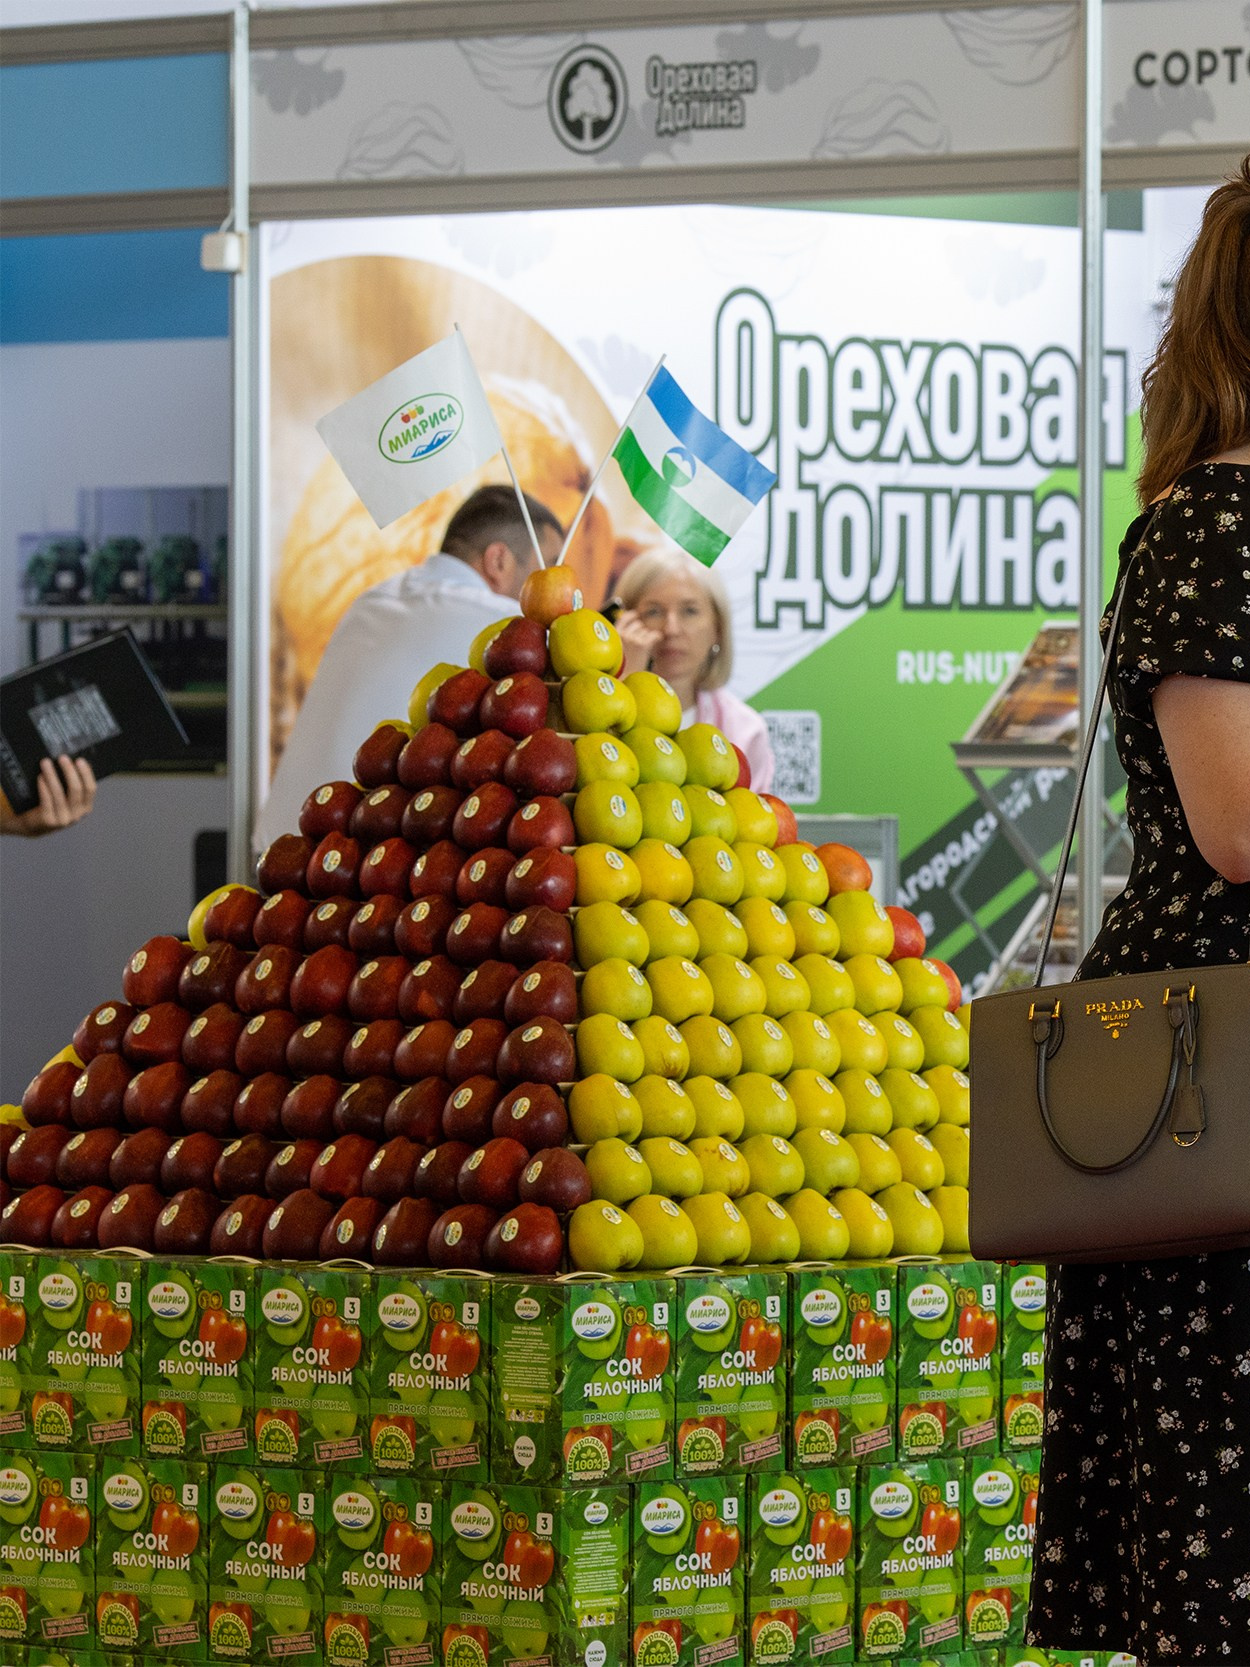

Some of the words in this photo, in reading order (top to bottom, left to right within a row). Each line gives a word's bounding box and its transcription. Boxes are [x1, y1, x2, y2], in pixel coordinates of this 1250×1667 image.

[645, 54, 758, 100] Ореховая
[387, 402, 457, 454] МИАРИСА
[1085, 998, 1145, 1015] PRADA
[1100, 1012, 1130, 1022] MILANO
[13, 1279, 21, 1293] 3
[41, 1286, 75, 1296] МИАРИСА
[120, 1286, 127, 1298] 3
[150, 1294, 187, 1305] МИАРИСА
[234, 1294, 241, 1307] 3
[880, 1293, 886, 1306] 3
[911, 1296, 945, 1306] МИАРИСА
[986, 1288, 992, 1301] 3
[264, 1301, 300, 1311] МИАРИСА
[348, 1301, 356, 1314] 3
[382, 1306, 416, 1317] МИАРИСА
[690, 1307, 726, 1318] МИАРИСА
[770, 1300, 777, 1312] 3
[804, 1301, 838, 1312] МИАРИСА
[467, 1306, 474, 1320] 3
[657, 1306, 664, 1320] 3
[575, 1314, 612, 1326] МИАРИСА
[67, 1331, 102, 1349] СОК
[941, 1337, 973, 1355] СОК
[180, 1340, 215, 1357] СОК
[833, 1344, 866, 1362] СОК
[48, 1351, 122, 1368] ЯБЛОЧНЫЙ
[293, 1347, 329, 1365] СОК
[410, 1353, 447, 1371] СОК
[721, 1350, 756, 1368] СОК
[159, 1360, 237, 1377] ЯБЛОЧНЫЙ
[606, 1358, 642, 1376] СОК
[919, 1353, 992, 1376] ЯБЛОЧНЫЙ
[272, 1367, 352, 1385] ЯБЛОЧНЫЙ
[812, 1360, 885, 1383] ЯБЛОЧНЫЙ
[388, 1373, 469, 1391] ЯБЛОЧНЫЙ
[698, 1367, 775, 1390] ЯБЛОЧНЫЙ
[46, 1379, 84, 1392] ПРЯМОГО
[583, 1374, 662, 1398] ЯБЛОЧНЫЙ
[157, 1388, 198, 1402] ПРЯМОГО
[920, 1388, 957, 1400] ПРЯМОГО
[271, 1396, 311, 1409] ПРЯМОГО
[813, 1395, 850, 1408] ПРЯМОГО
[388, 1402, 427, 1416] ПРЯМОГО
[698, 1402, 738, 1415] ПРЯМОГО
[584, 1411, 624, 1424] ПРЯМОГО
[40, 1422, 65, 1435] 100%
[1014, 1424, 1039, 1436] 100%
[151, 1432, 178, 1445] 100%
[911, 1434, 937, 1446] 100%
[264, 1440, 291, 1453] 100%
[805, 1441, 830, 1454] 100%
[380, 1446, 406, 1461] 100%
[689, 1449, 716, 1462] 100%
[575, 1458, 602, 1471] 100%
[75, 1481, 83, 1494] 3
[105, 1486, 140, 1498] МИАРИСА
[949, 1484, 956, 1497] 3
[976, 1482, 1010, 1494] МИАРИСА
[187, 1488, 194, 1501] 3
[219, 1495, 254, 1506] МИАРИСА
[840, 1492, 847, 1505] 3
[874, 1494, 909, 1505] МИАРИСА
[303, 1497, 310, 1510] 3
[336, 1504, 370, 1515] МИАРИСА
[727, 1501, 734, 1514] 3
[762, 1501, 797, 1513] МИАРИСА
[420, 1506, 428, 1520] 3
[644, 1509, 681, 1521] МИАРИСА
[454, 1514, 490, 1526] МИАРИСА
[541, 1516, 548, 1530] 3
[21, 1526, 56, 1544] СОК
[133, 1532, 168, 1551] СОК
[247, 1541, 283, 1560] СОК
[903, 1535, 936, 1554] СОК
[1, 1546, 79, 1563] ЯБЛОЧНЫЙ
[792, 1543, 826, 1562] СОК
[984, 1543, 1034, 1562] ЯБЛОЧН
[113, 1552, 189, 1570] ЯБЛОЧНЫЙ
[364, 1552, 400, 1571] СОК
[676, 1552, 711, 1571] СОК
[881, 1550, 954, 1574] ЯБЛОЧНЫЙ
[226, 1561, 305, 1580] ЯБЛОЧНЫЙ
[483, 1562, 520, 1581] СОК
[770, 1559, 844, 1583] ЯБЛОЧНЫЙ
[111, 1580, 151, 1594] ПРЯМОГО
[342, 1571, 423, 1591] ЯБЛОЧНЫЙ
[652, 1568, 732, 1593] ЯБЛОЧНЫЙ
[985, 1574, 1022, 1587] ПРЯМОГО
[224, 1589, 264, 1604] ПРЯМОГО
[461, 1582, 543, 1602] ЯБЛОЧНЫЙ
[881, 1586, 919, 1599] ПРЯМОГО
[341, 1600, 380, 1615] ПРЯМОГО
[770, 1595, 809, 1608] ПРЯМОГО
[653, 1605, 693, 1618] ПРЯМОГО
[460, 1611, 500, 1626] ПРЯМОГО
[105, 1623, 131, 1637] 100%
[977, 1620, 1002, 1632] 100%
[217, 1633, 244, 1647] 100%
[873, 1632, 898, 1645] 100%
[335, 1644, 360, 1659] 100%
[762, 1642, 788, 1655] 100%
[644, 1652, 671, 1665] 100%
